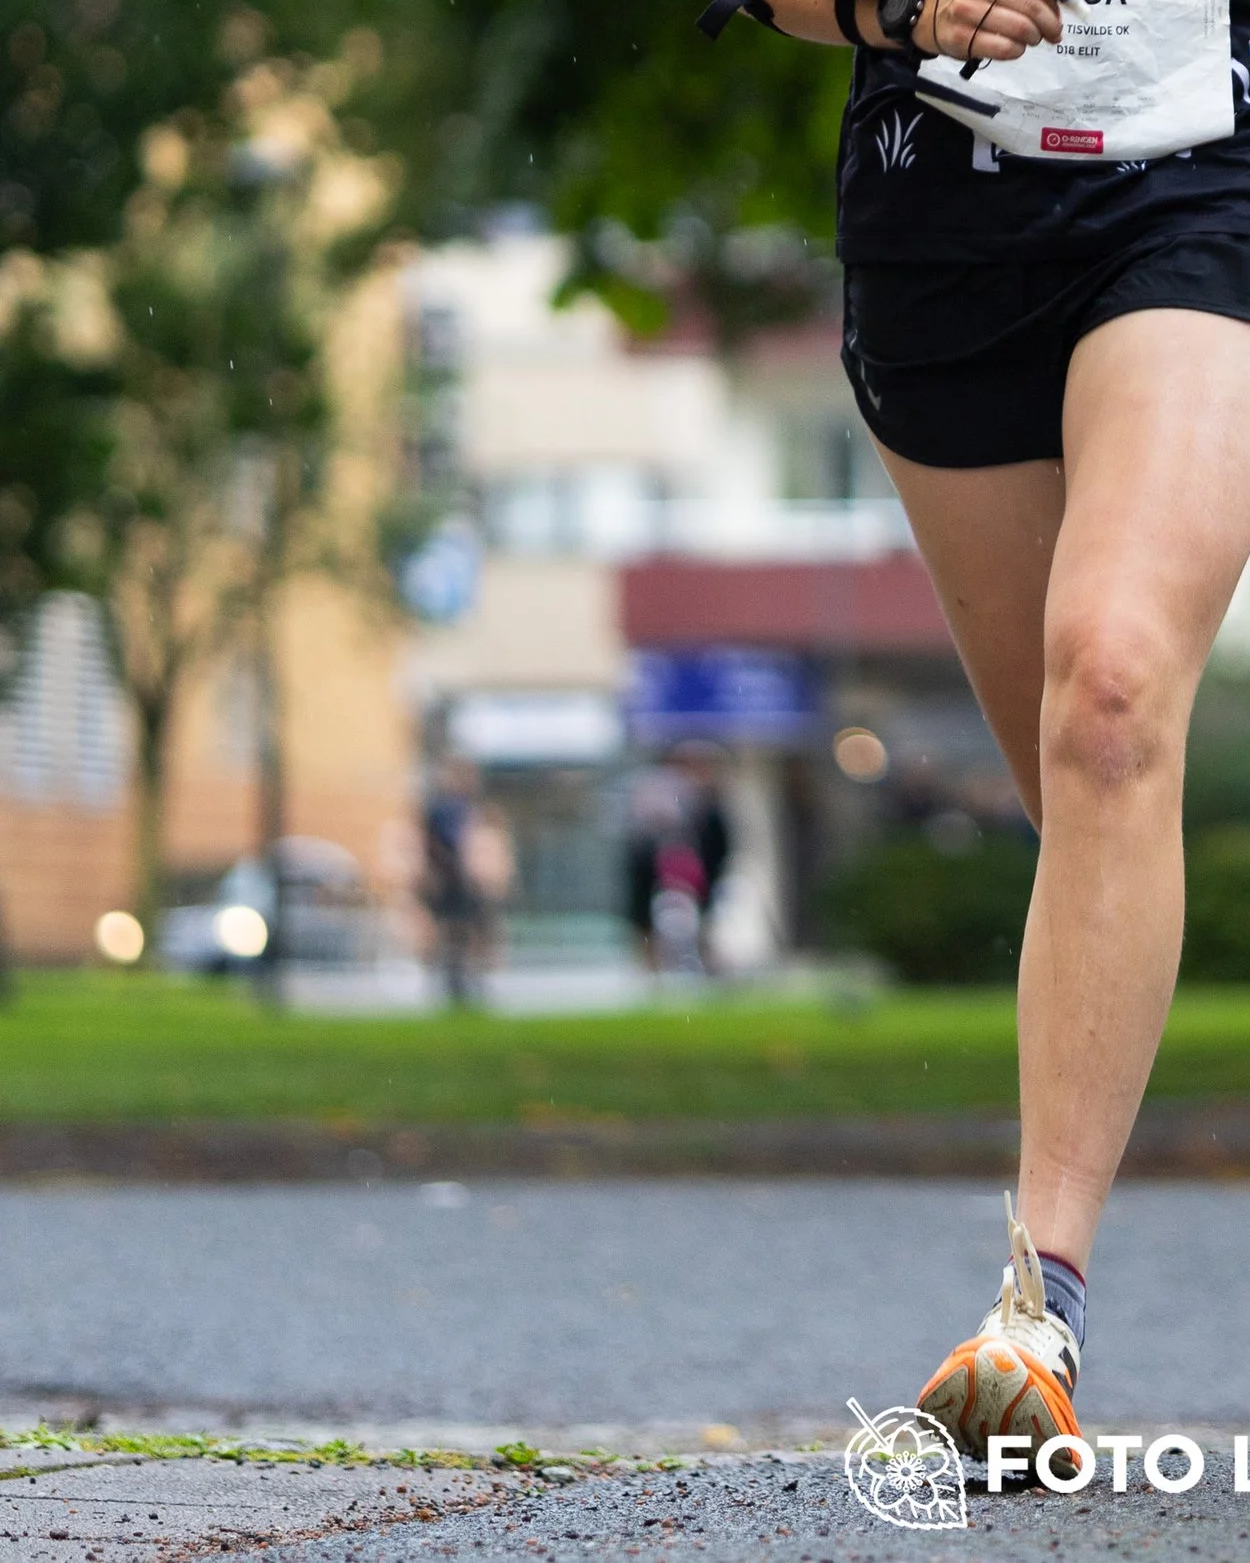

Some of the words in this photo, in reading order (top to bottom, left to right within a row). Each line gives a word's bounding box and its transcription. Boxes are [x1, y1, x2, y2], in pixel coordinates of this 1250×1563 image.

[1067, 24, 1113, 36] TISVILDE
[1115, 25, 1130, 35] OK
[1056, 44, 1075, 55] D18
[1078, 46, 1101, 56] ELIT
